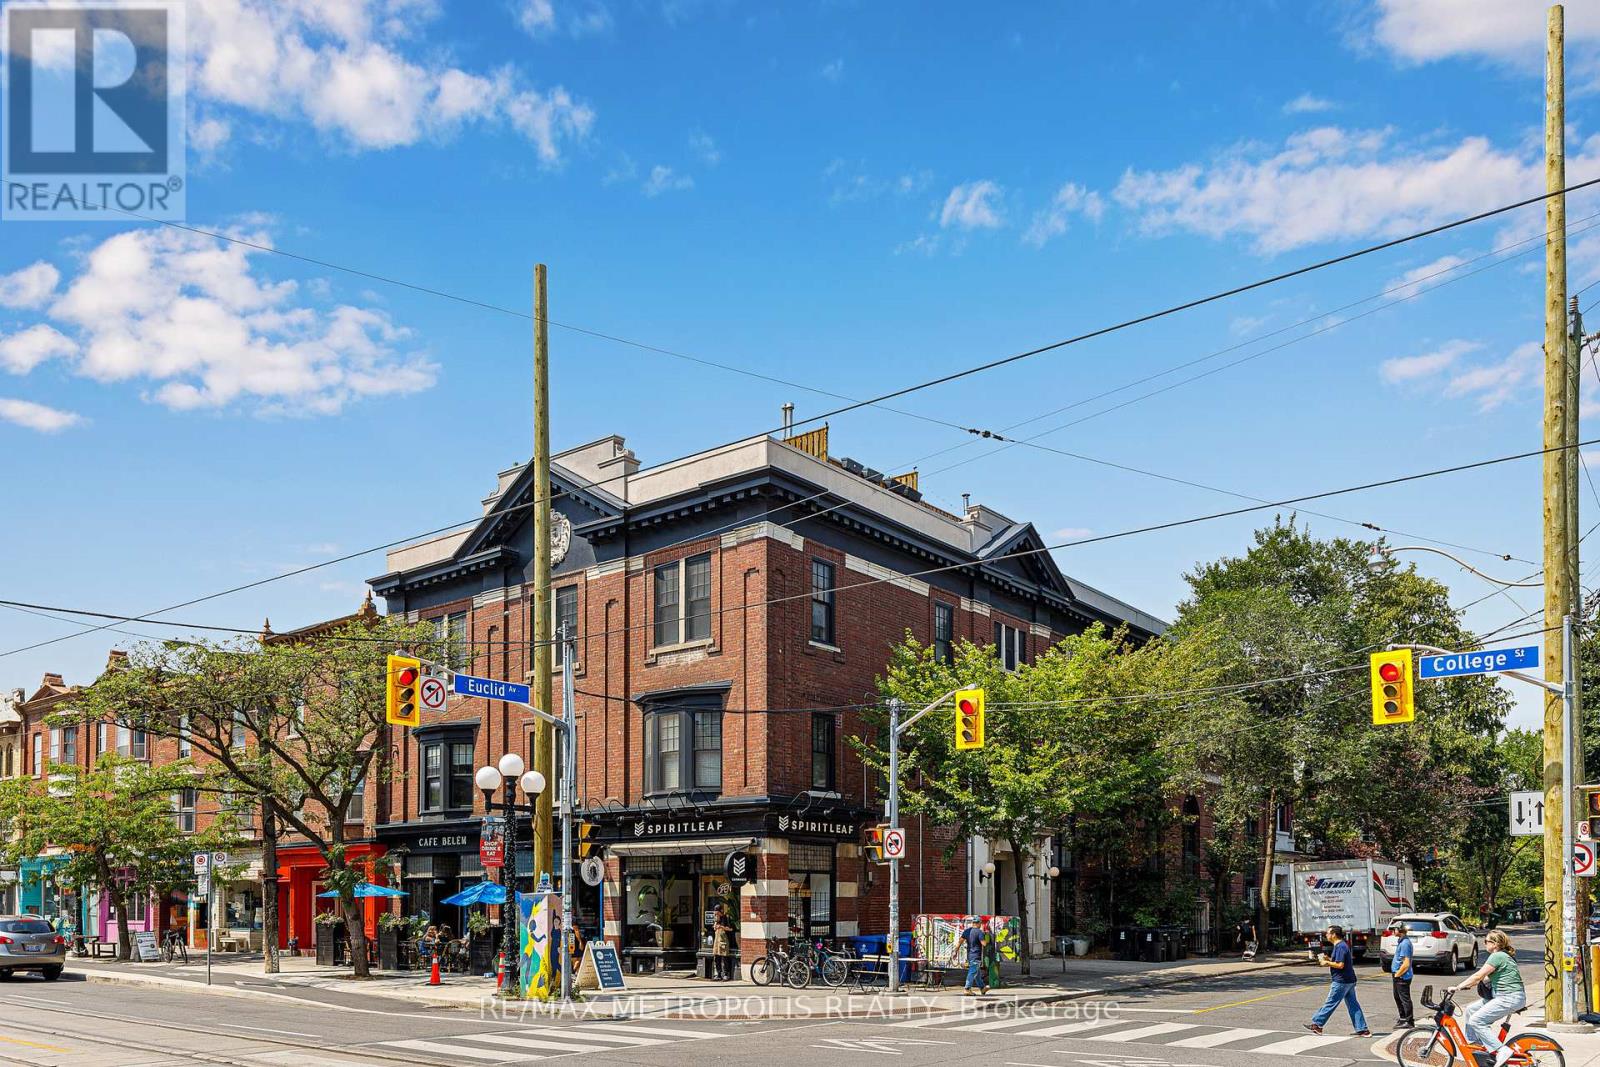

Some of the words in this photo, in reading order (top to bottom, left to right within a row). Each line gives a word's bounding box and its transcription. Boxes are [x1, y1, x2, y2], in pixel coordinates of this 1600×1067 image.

[1433, 653, 1507, 671] College
[1514, 648, 1525, 658] St
[468, 679, 505, 697] Euclid
[508, 685, 517, 693] Av
[647, 821, 723, 834] SPIRITLEAF
[791, 820, 854, 834] SPIRITLEAF
[418, 837, 438, 847] CAFE
